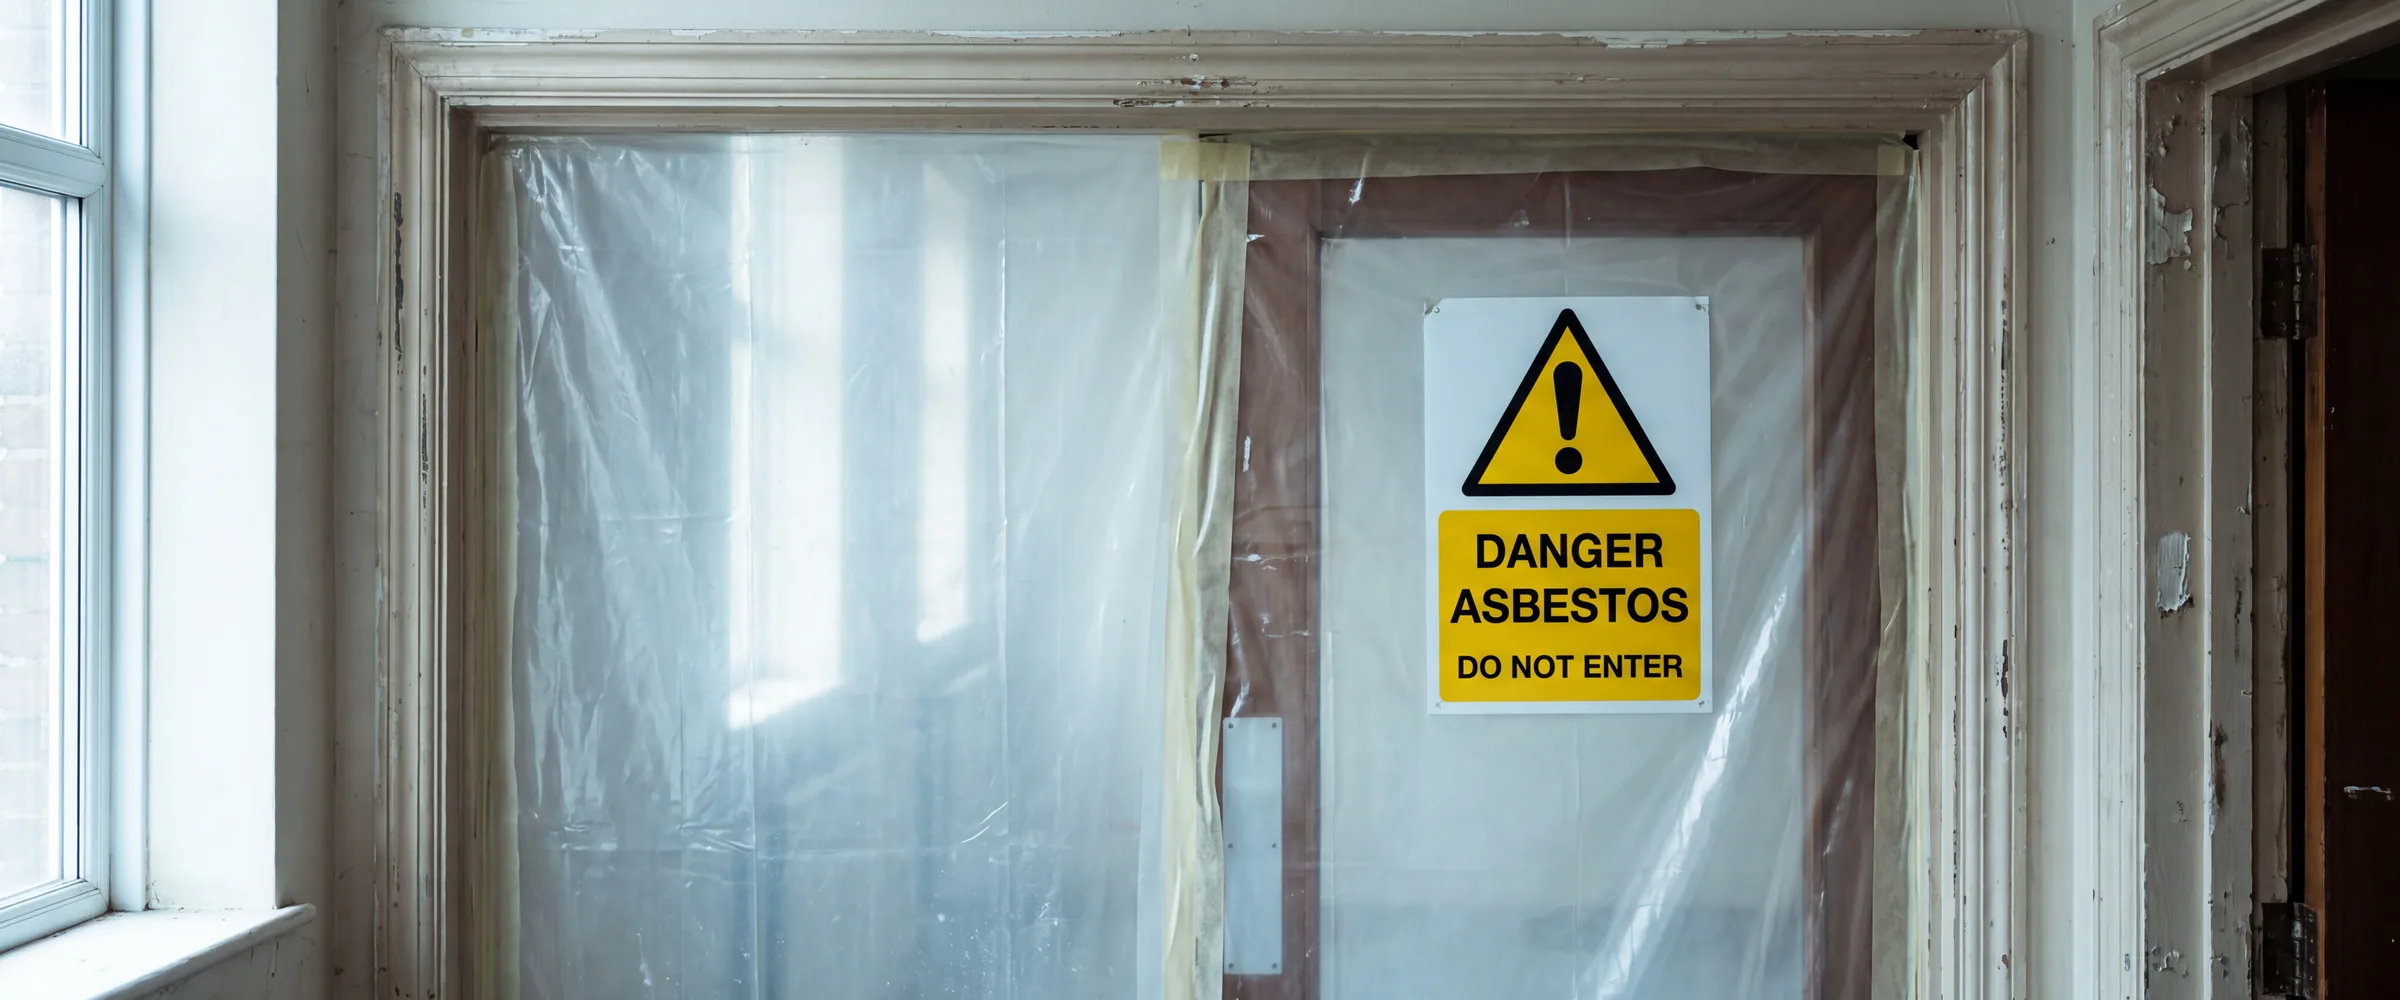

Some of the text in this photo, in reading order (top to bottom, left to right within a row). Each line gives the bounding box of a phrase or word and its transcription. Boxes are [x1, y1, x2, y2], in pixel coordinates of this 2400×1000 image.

[1476, 533, 1664, 569] DANGER
[1450, 587, 1689, 624] ASBESTOS
[1458, 655, 1683, 679] DO NOT ENTER
